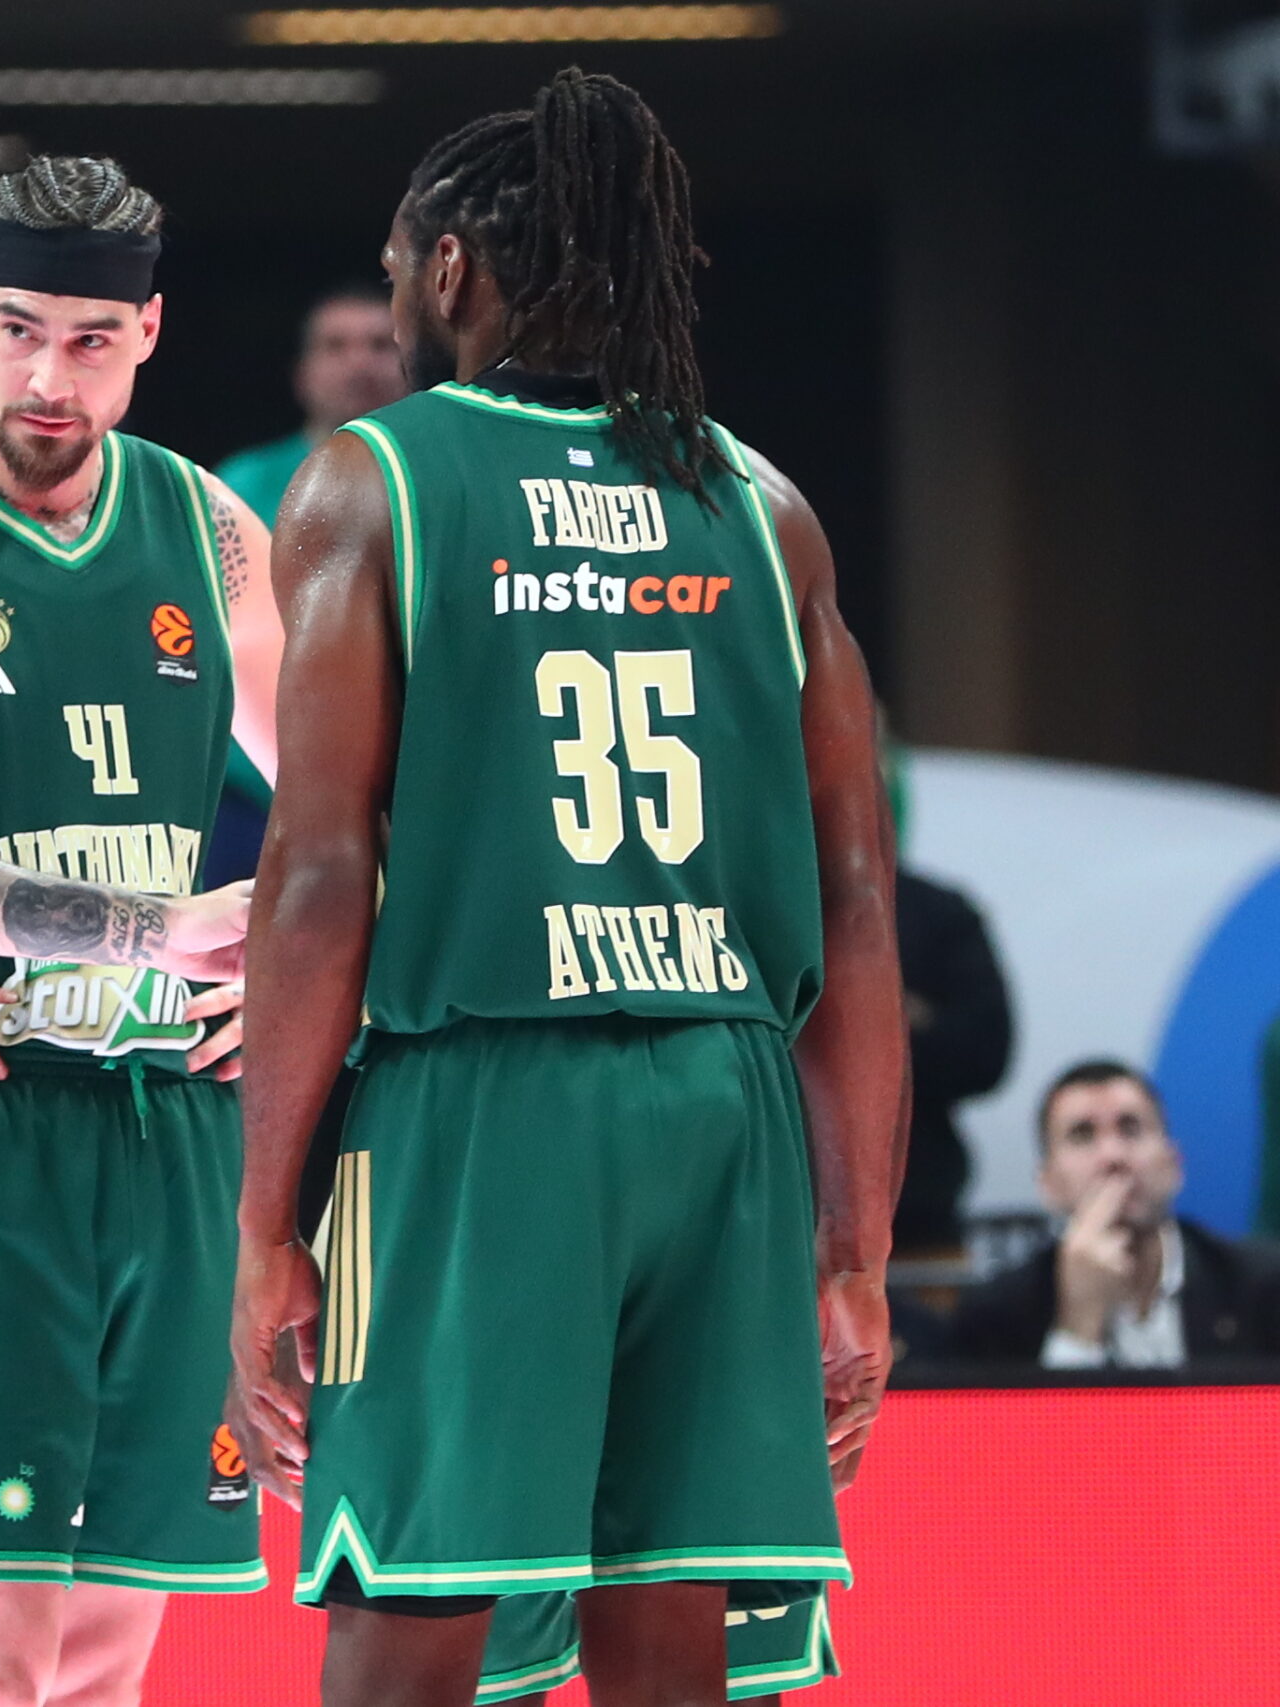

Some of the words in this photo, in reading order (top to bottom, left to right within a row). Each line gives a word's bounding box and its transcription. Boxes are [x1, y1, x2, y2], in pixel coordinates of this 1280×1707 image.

[519, 478, 668, 554] FARIED
[492, 558, 732, 615] instacar
[62, 704, 139, 796] 41
[535, 649, 704, 865] 35
[543, 902, 749, 1000] ATHENS
